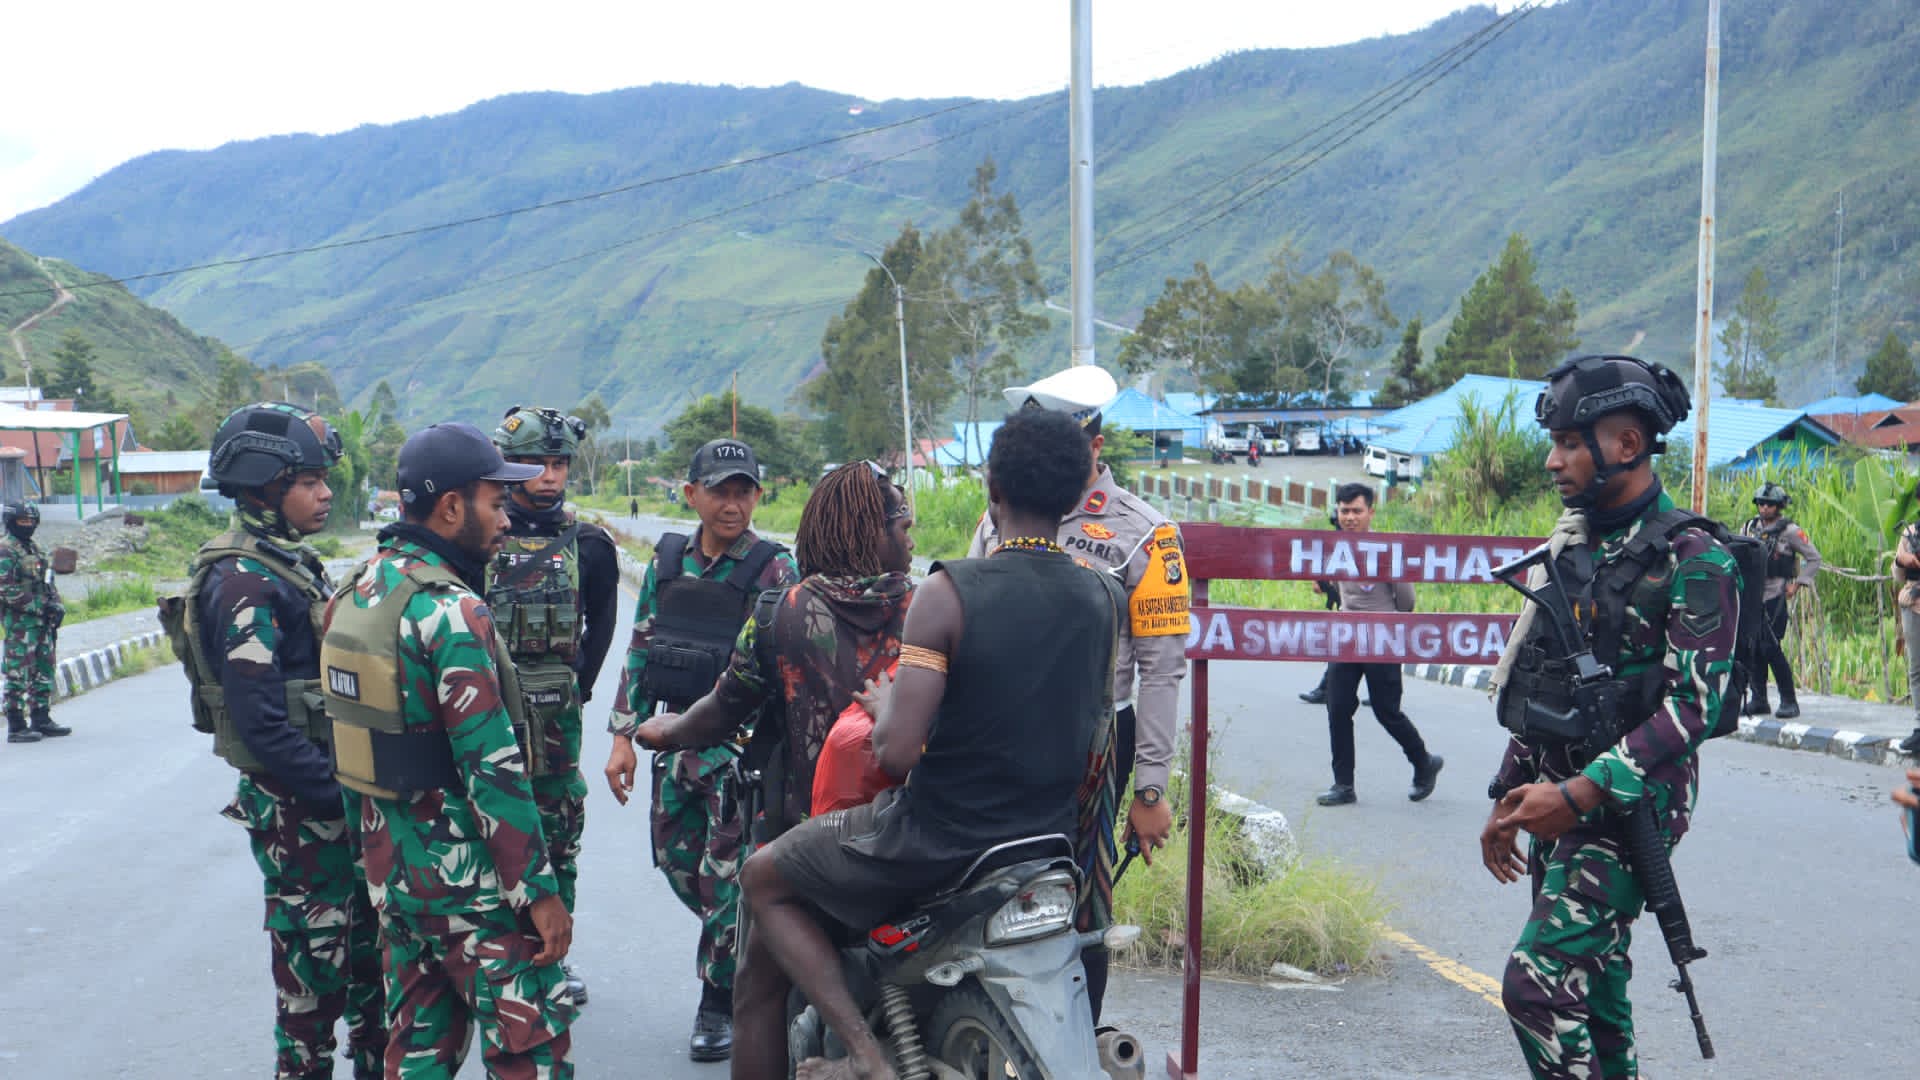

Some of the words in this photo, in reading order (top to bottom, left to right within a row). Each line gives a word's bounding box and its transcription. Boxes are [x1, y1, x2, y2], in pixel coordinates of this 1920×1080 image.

[716, 446, 745, 458] 1714
[1065, 536, 1111, 560] POLRI
[1242, 619, 1441, 658] SWEPING
[1452, 620, 1513, 657] GA
